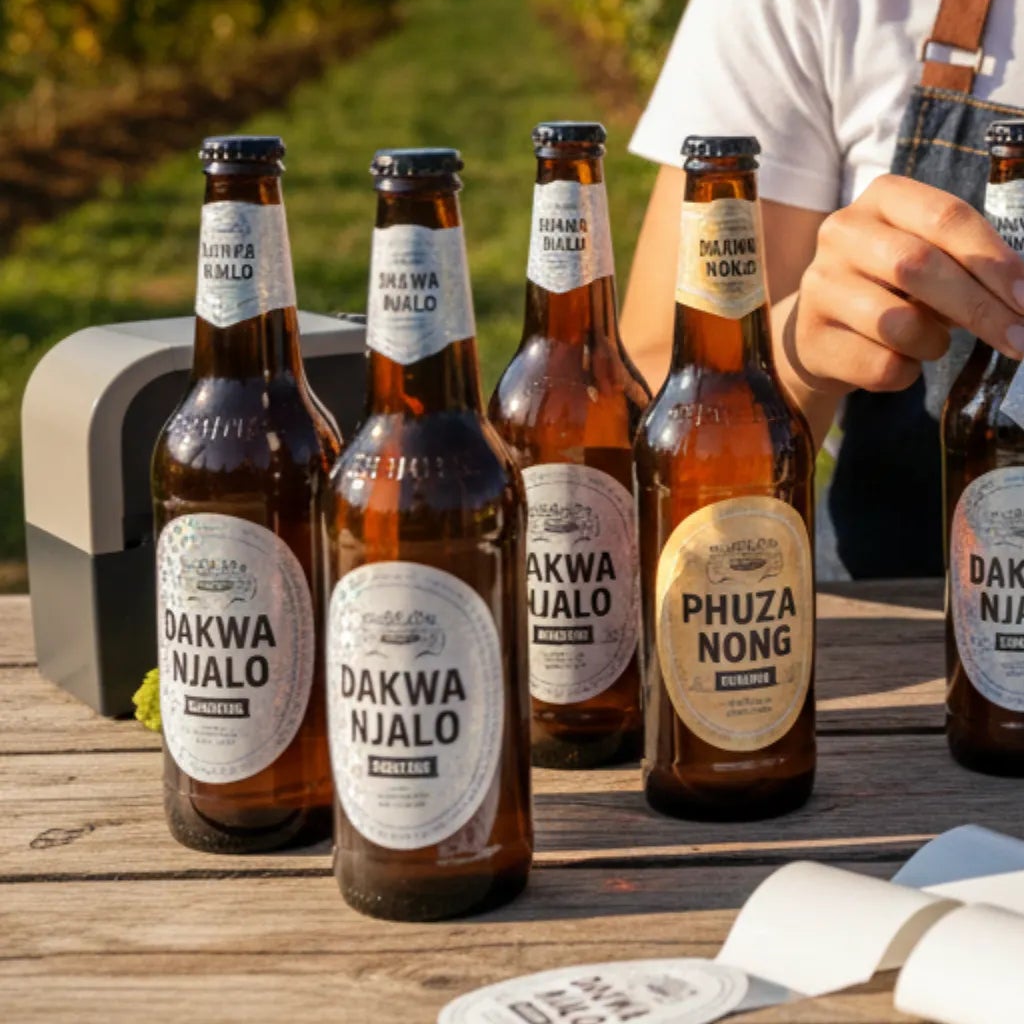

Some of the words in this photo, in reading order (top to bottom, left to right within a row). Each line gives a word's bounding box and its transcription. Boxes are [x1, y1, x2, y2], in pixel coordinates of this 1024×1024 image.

[526, 552, 616, 583] AKWA
[682, 586, 796, 625] PHUZA
[165, 609, 276, 649] DAKWA
[698, 626, 792, 664] NONG
[172, 654, 269, 689] NJALO
[341, 664, 466, 706] DAKWA
[351, 710, 460, 747] NJALO
